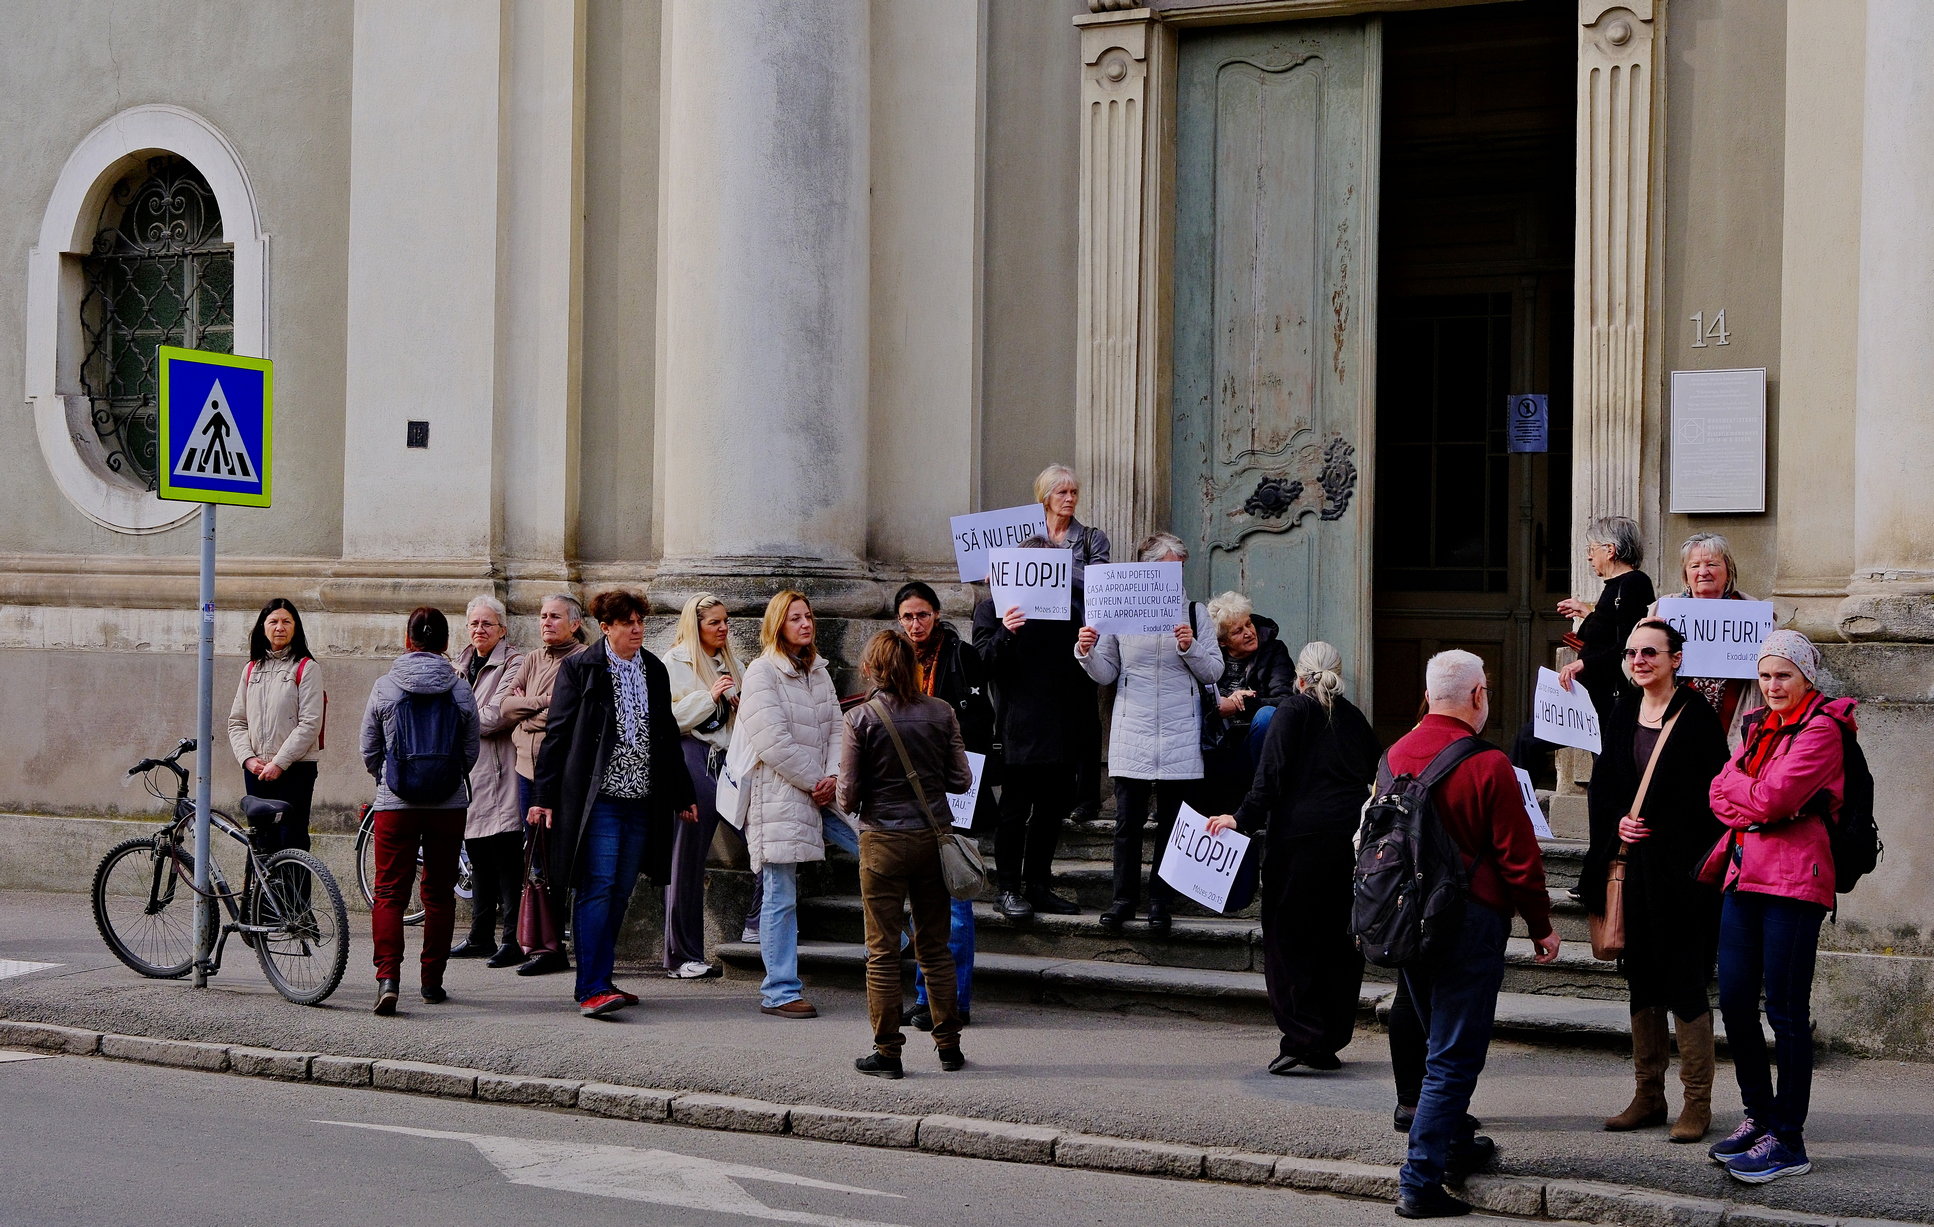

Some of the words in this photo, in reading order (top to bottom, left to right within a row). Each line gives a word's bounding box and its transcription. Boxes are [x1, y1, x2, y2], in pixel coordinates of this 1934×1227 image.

[1689, 308, 1731, 348] 14
[982, 527, 1003, 549] NU
[991, 561, 1009, 587] NE
[1015, 561, 1067, 588] LOPJ!
[1116, 570, 1127, 580] NU
[1086, 584, 1104, 594] CASA
[1105, 583, 1149, 593] APROAPELUI
[1151, 582, 1164, 592] TĂU
[1085, 597, 1097, 607] NICI
[1098, 596, 1122, 606] VREUN
[1123, 596, 1136, 606] ALT
[1137, 595, 1161, 605] LUCRU
[1162, 595, 1181, 604] CARE
[1052, 606, 1068, 614] 20:15
[1087, 609, 1102, 619] ESTE
[1103, 609, 1113, 618] AL
[1113, 608, 1159, 618] APROAPELUI
[1143, 624, 1162, 632] Exodul
[1693, 619, 1716, 642] NU
[1722, 620, 1771, 644] FURI.”
[1726, 652, 1748, 661] Exodul
[1567, 707, 1584, 731] NU
[954, 816, 968, 825] 0:17
[1170, 816, 1190, 851] NE
[1185, 828, 1239, 877] LOPJ!
